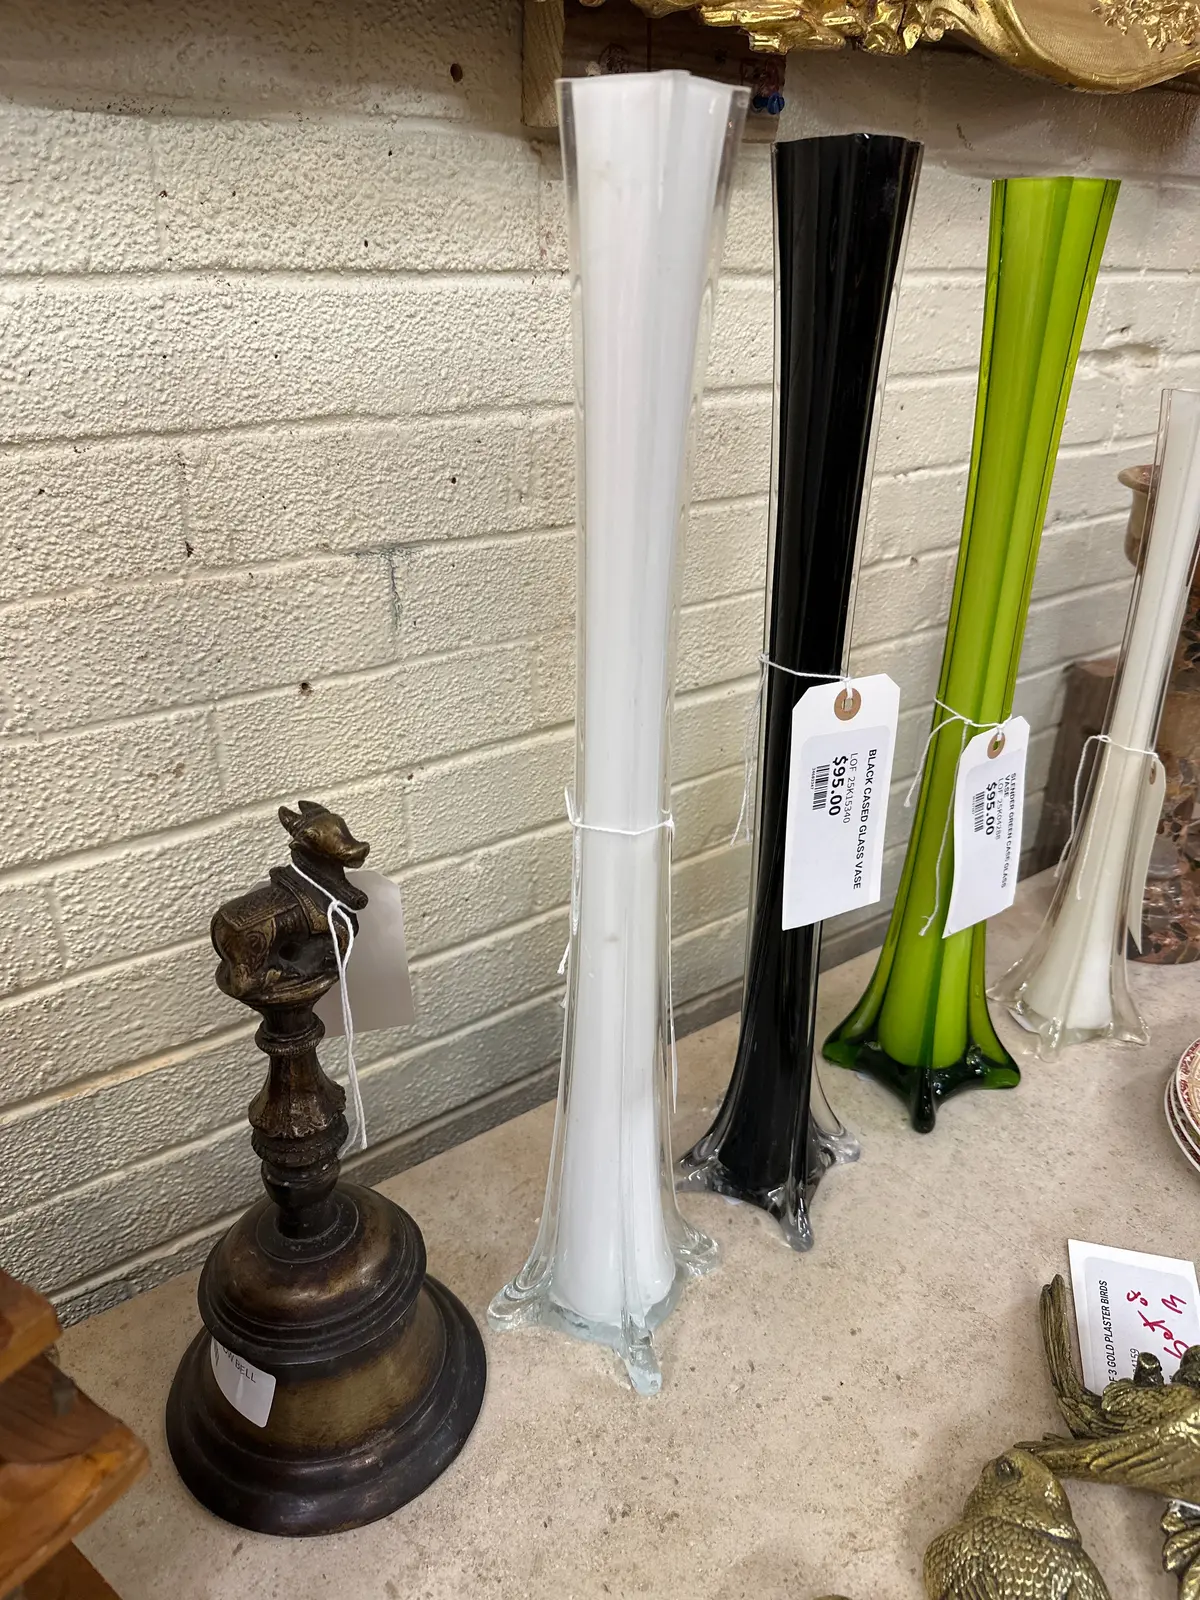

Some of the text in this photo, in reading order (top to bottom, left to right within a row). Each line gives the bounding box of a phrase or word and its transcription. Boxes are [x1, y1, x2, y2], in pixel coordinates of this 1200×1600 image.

[828, 755, 849, 816] $95.00
[843, 752, 858, 824] LOF 25K15340
[1009, 773, 1017, 811] SLENDER
[853, 749, 877, 890] BLACK CASED GLASS VASE
[986, 782, 998, 836] $95.00
[1001, 863, 1010, 888] GLASS
[1099, 1280, 1109, 1304] BIRDS
[1101, 1305, 1113, 1343] PLASTER
[235, 1358, 256, 1383] BELL
[1106, 1345, 1116, 1368] GOLD
